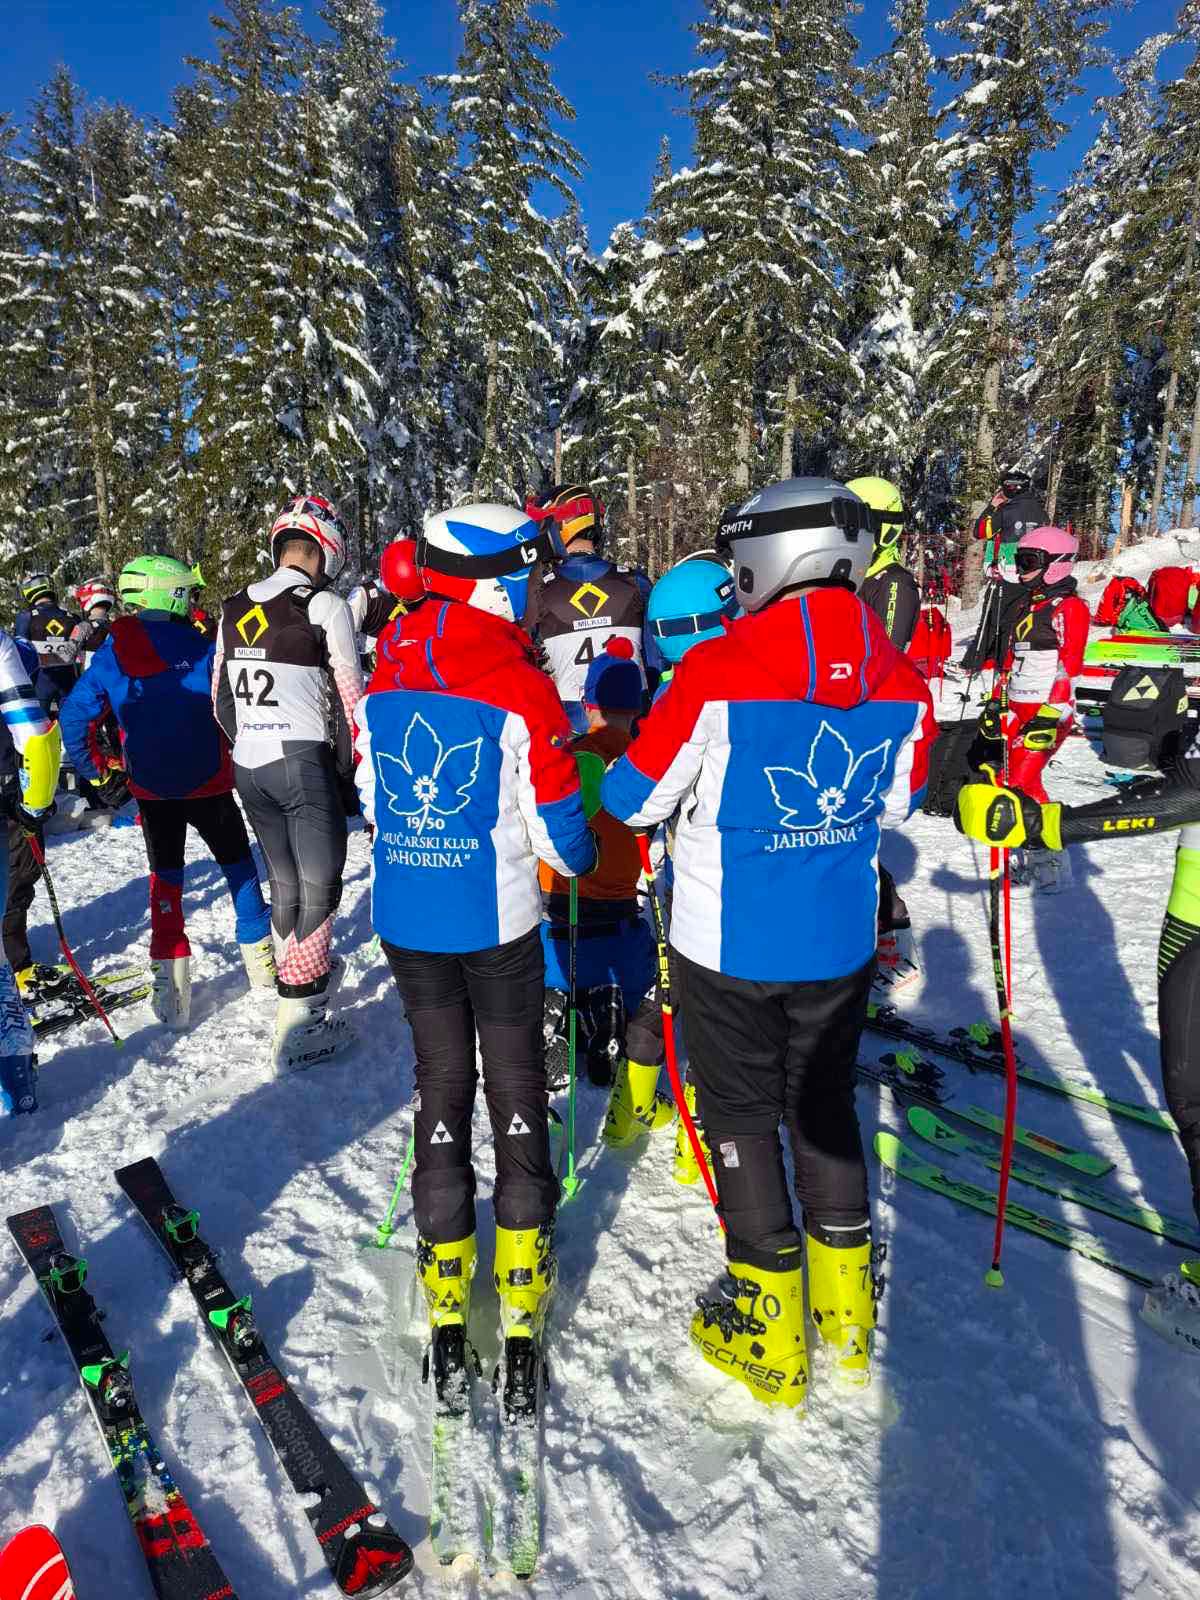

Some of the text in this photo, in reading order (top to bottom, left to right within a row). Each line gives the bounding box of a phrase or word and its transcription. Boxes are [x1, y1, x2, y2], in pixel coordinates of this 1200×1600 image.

[721, 520, 753, 536] SMITH
[235, 668, 279, 706] 42
[1103, 817, 1156, 832] LEKI
[443, 838, 480, 850] KLUB
[658, 943, 671, 989] LEKI
[318, 1502, 376, 1545] ROSSIGNOL
